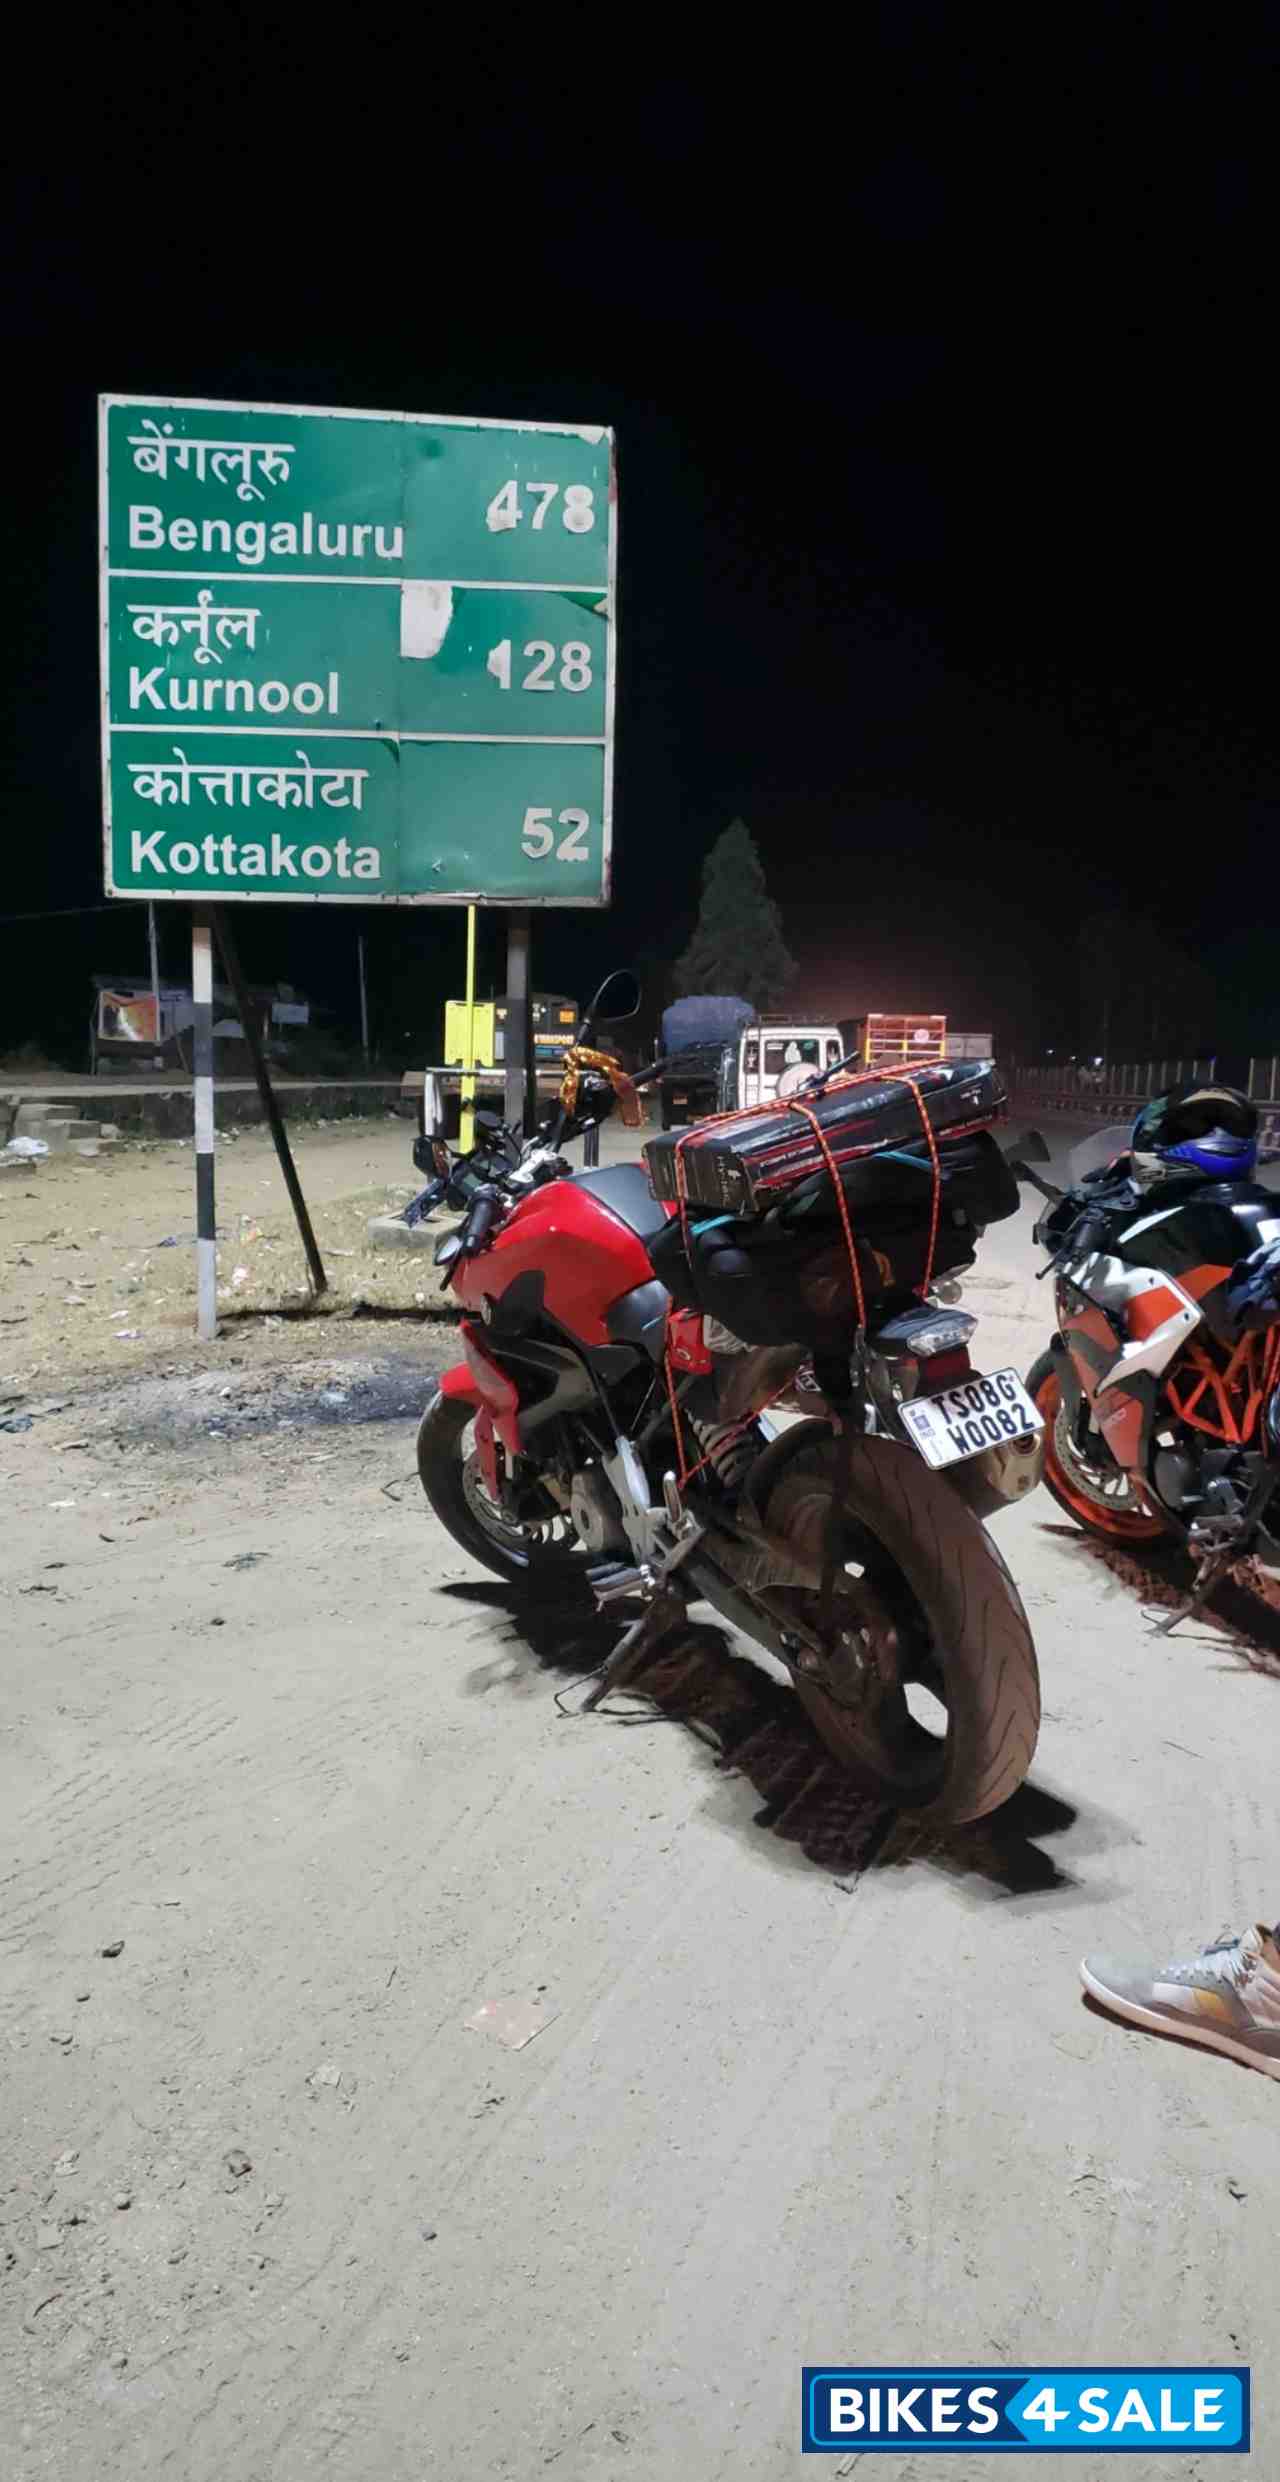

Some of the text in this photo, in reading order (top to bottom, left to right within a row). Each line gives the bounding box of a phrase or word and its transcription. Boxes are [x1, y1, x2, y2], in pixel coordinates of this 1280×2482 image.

[127, 419, 296, 501] बेंगलूरु
[485, 479, 595, 534] 478
[128, 505, 404, 565] Bengaluru
[127, 589, 262, 665] कर्नूल
[129, 666, 339, 714] Kurnool
[487, 639, 593, 692] 128
[127, 747, 369, 810] कोत्ताकोटा
[131, 830, 382, 880] Kottakota
[520, 807, 590, 862] 52
[930, 1374, 1017, 1425] TS08G
[946, 1403, 1035, 1455] W0082
